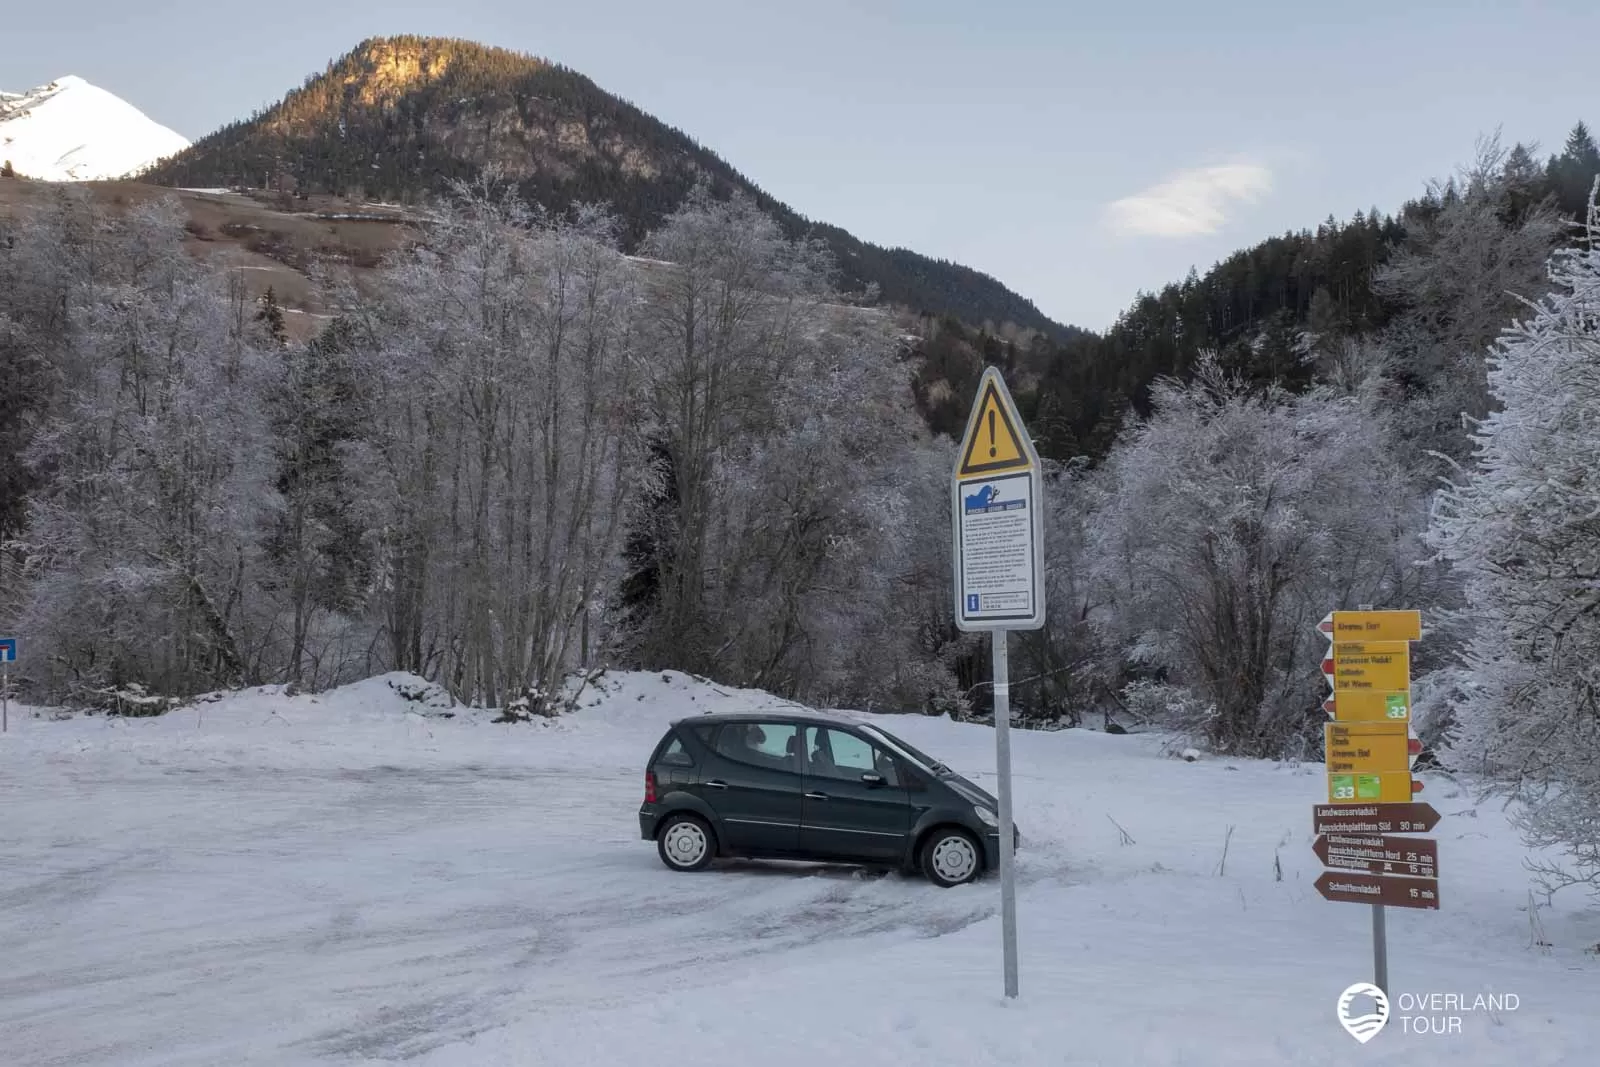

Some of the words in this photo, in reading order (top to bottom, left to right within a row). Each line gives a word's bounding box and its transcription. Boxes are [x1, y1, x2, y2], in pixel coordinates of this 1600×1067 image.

[1317, 807, 1378, 817] Landwasserviadukt
[1319, 821, 1378, 833] Aussichtsplattform
[1378, 821, 1391, 831] Süd
[1400, 821, 1410, 831] 30
[1413, 822, 1426, 831] min
[1328, 845, 1384, 858] Aussichtsplattform
[1385, 849, 1401, 861] Nord
[1406, 852, 1418, 862] 25
[1420, 853, 1433, 863] min
[1409, 864, 1418, 873] 15
[1421, 865, 1433, 875] min
[1409, 888, 1418, 898] 15
[1421, 889, 1435, 899] min
